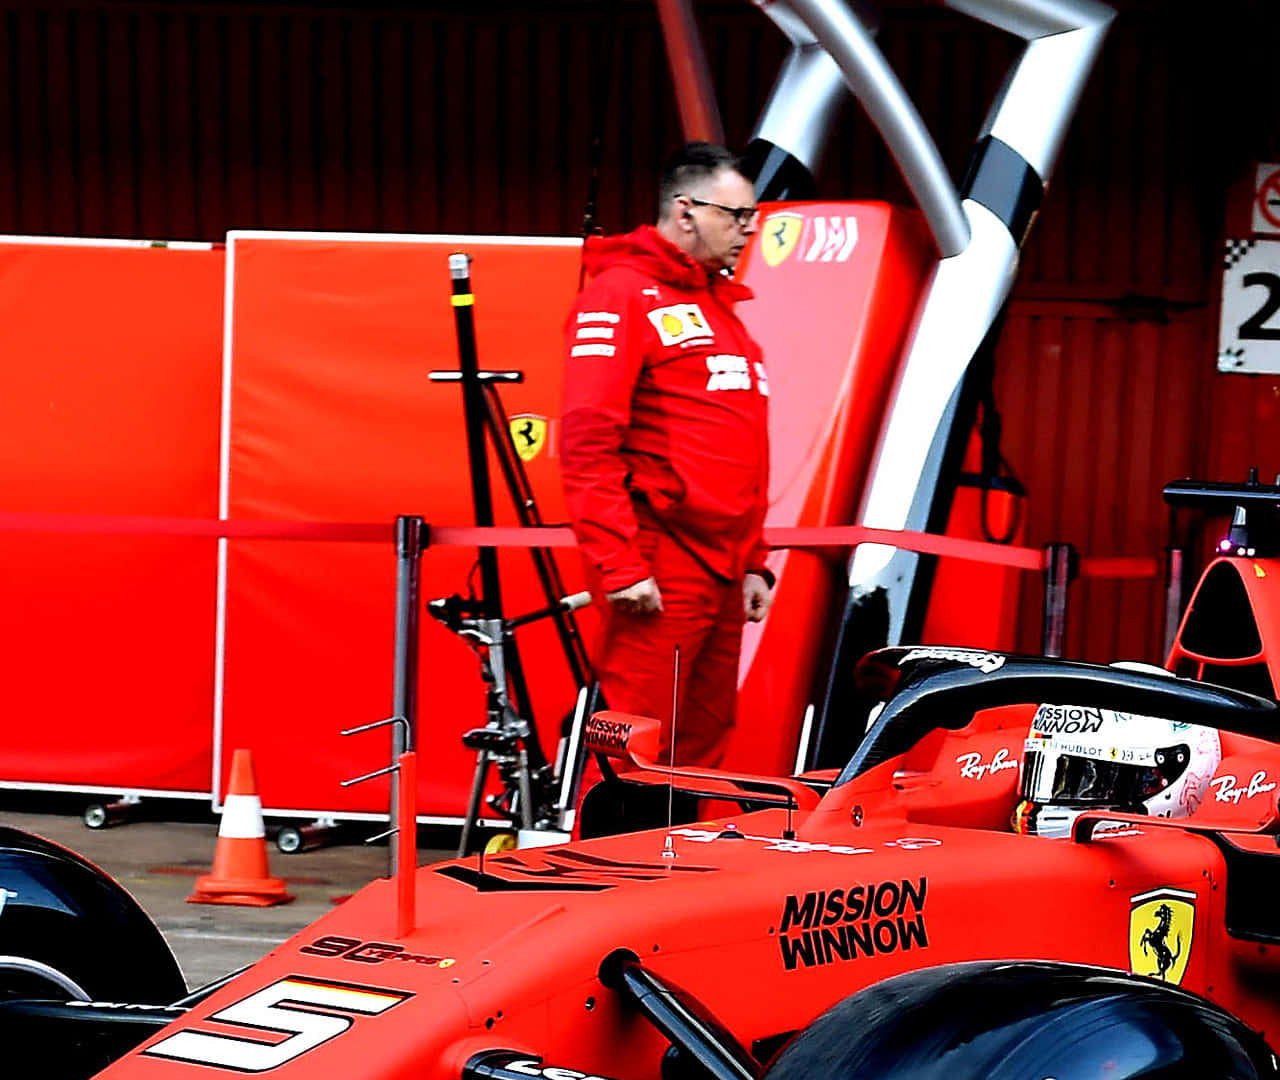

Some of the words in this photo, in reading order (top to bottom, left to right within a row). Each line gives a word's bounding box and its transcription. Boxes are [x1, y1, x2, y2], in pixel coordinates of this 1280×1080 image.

[586, 716, 632, 734] MISSION
[1061, 744, 1102, 756] HUBLOT
[779, 877, 927, 932] MISSION
[778, 915, 928, 970] WINNOW
[138, 975, 417, 1073] 5
